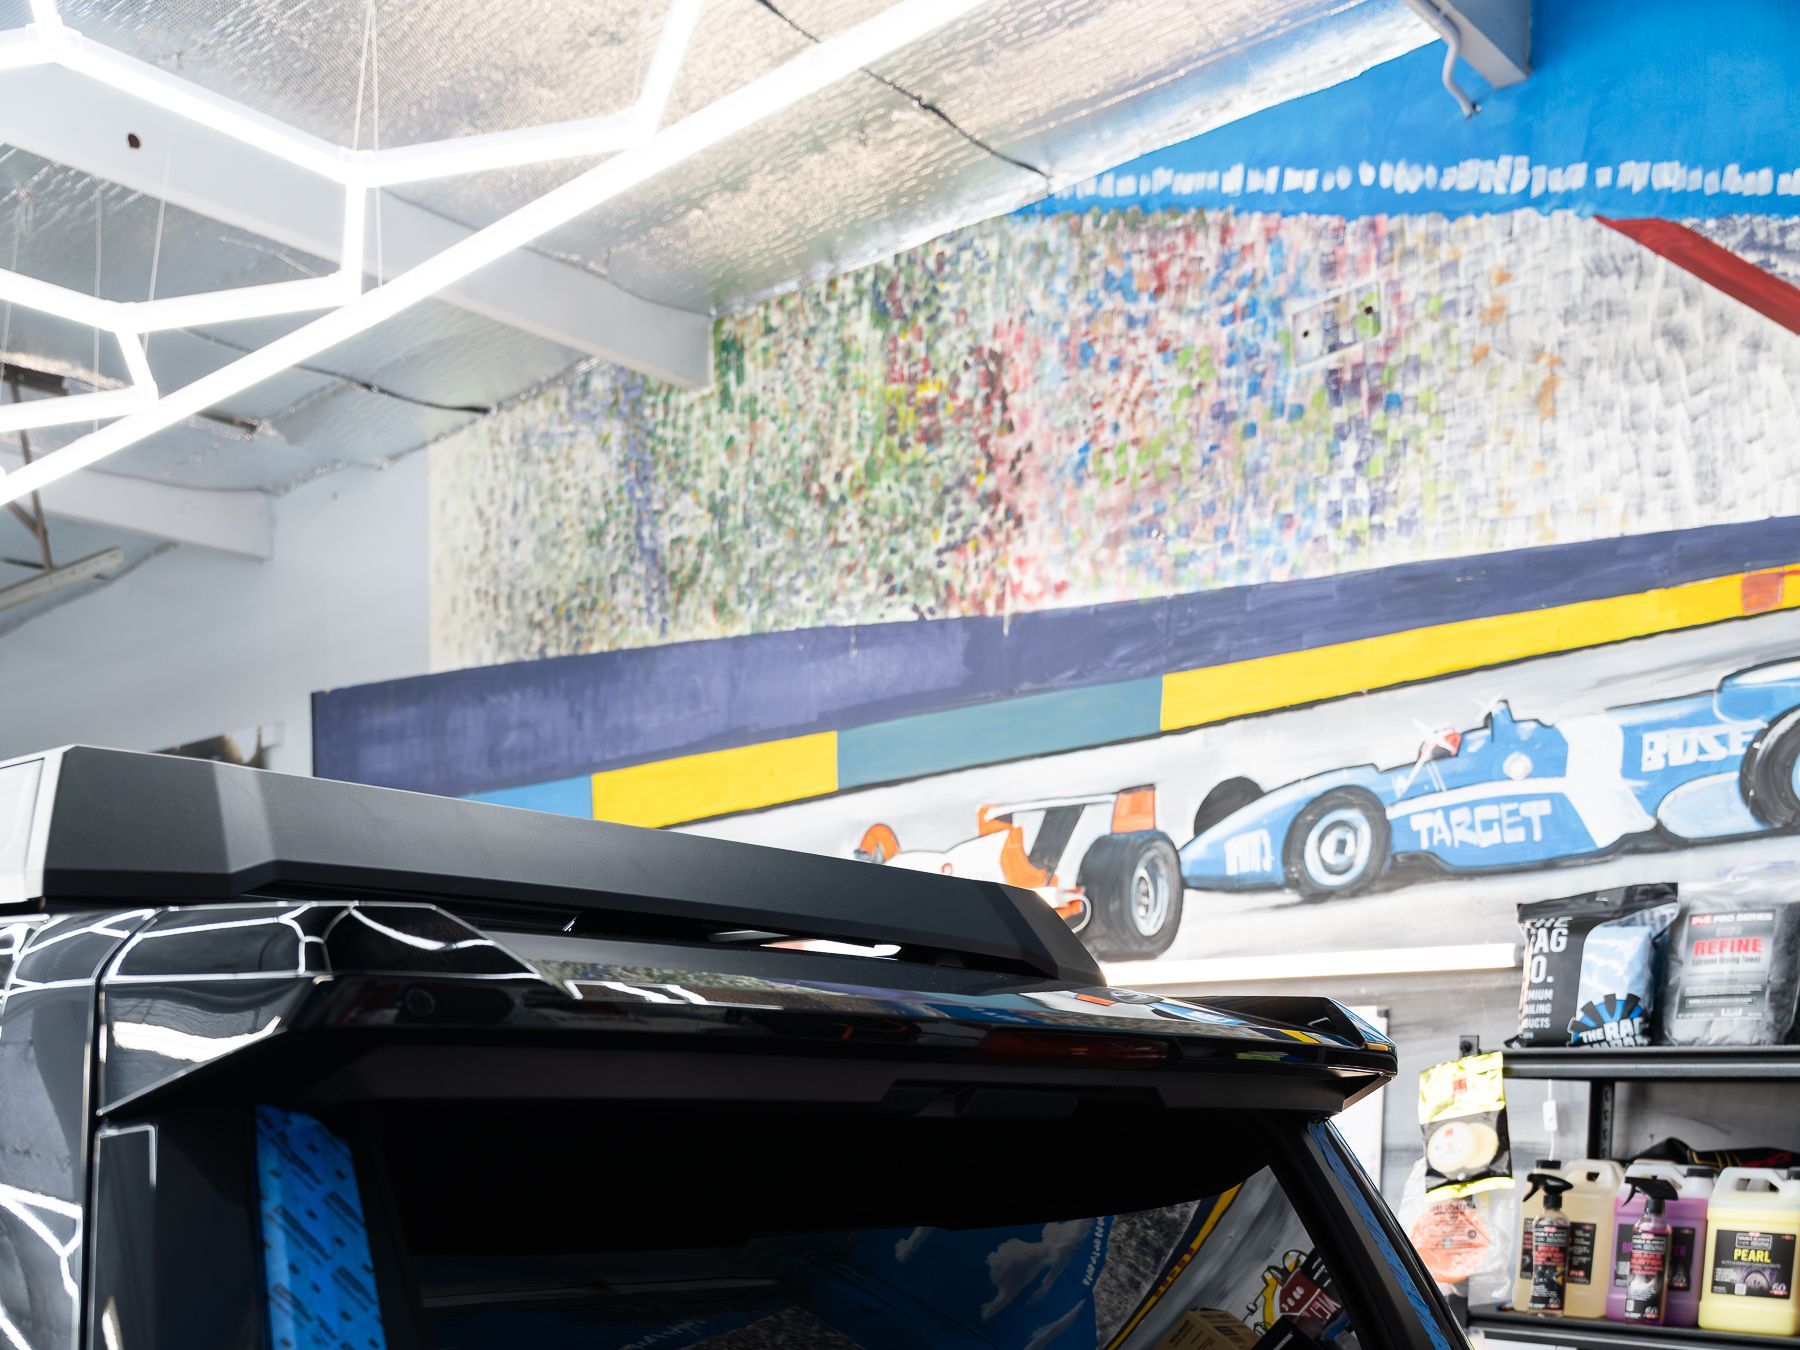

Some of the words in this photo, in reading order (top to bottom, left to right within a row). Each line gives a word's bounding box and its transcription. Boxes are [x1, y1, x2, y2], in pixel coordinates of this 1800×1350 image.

[1641, 722, 1765, 772] BOSE
[1410, 800, 1552, 850] TARGET
[1532, 927, 1569, 953] AG
[1693, 936, 1764, 957] REFINE
[1527, 989, 1554, 1001] MIUM
[1579, 1029, 1604, 1044] THE
[1733, 1248, 1771, 1264] PEARL
